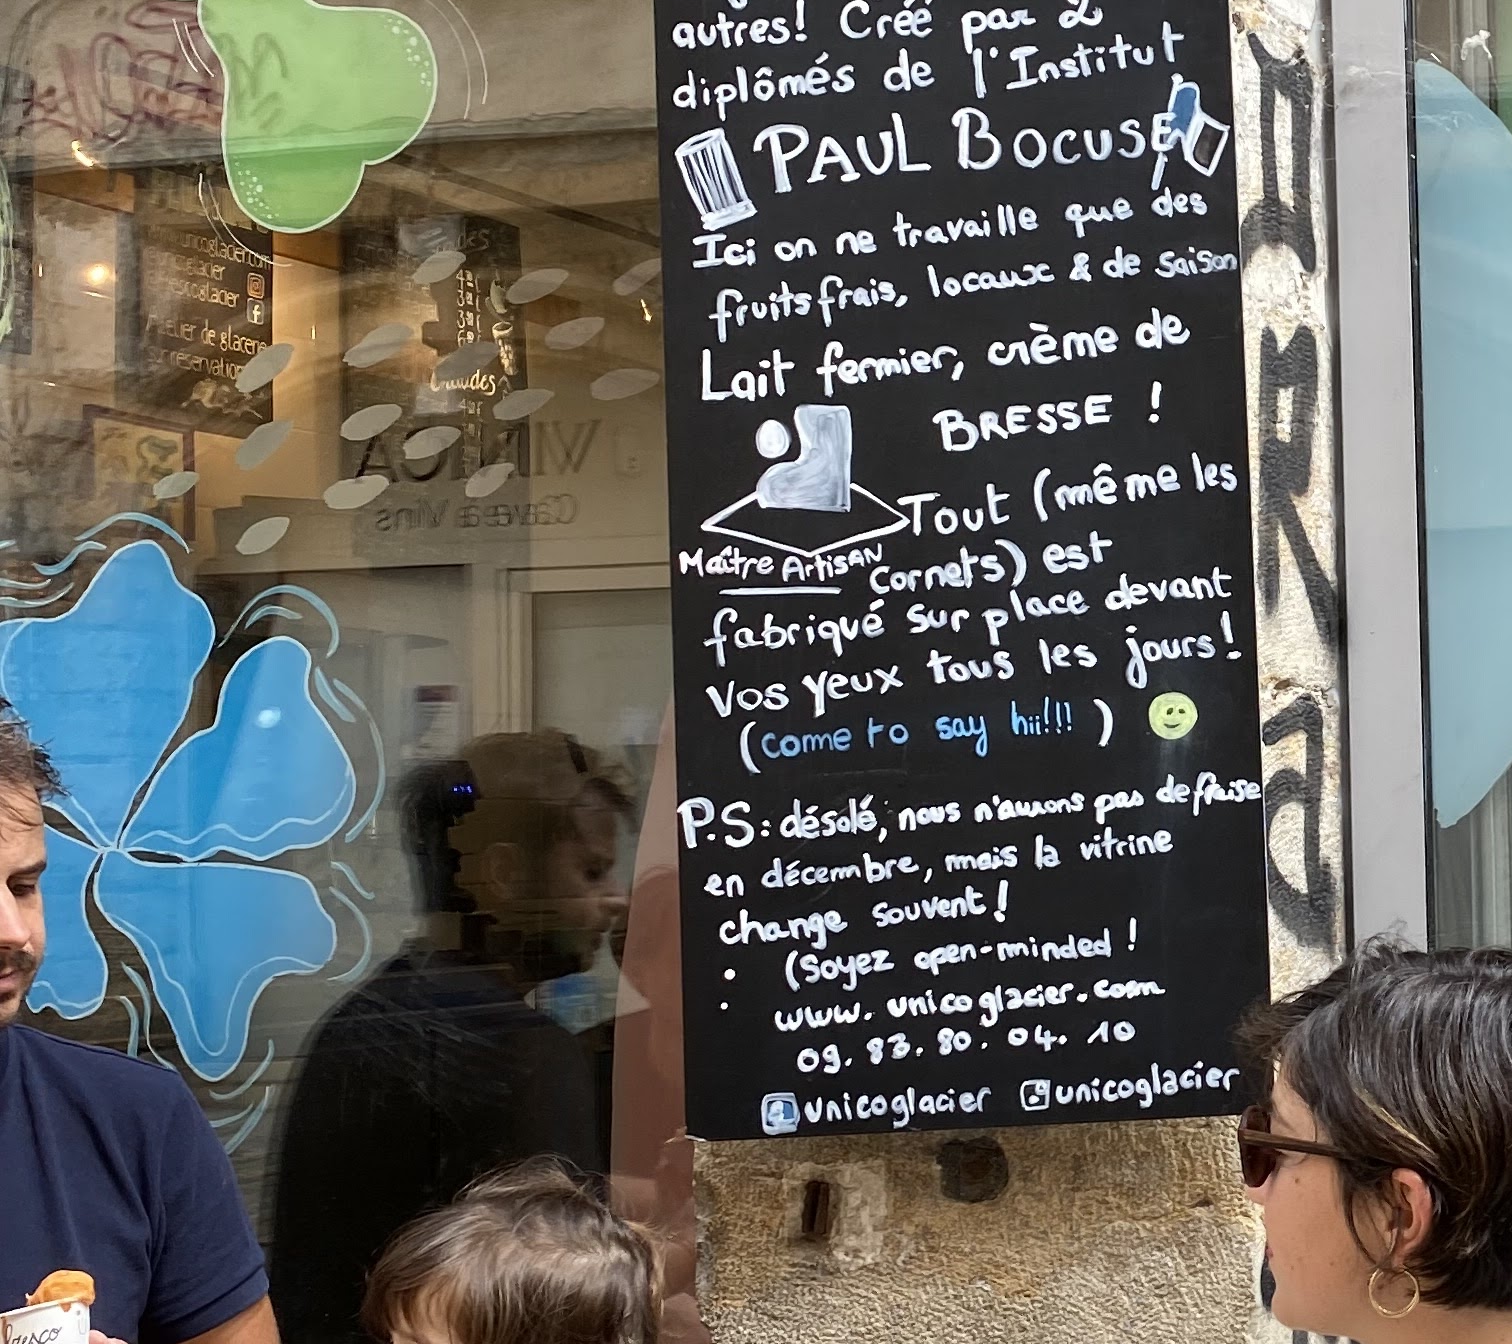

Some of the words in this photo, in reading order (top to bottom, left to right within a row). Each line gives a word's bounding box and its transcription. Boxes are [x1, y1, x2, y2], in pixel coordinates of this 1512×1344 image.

[672, 0, 807, 51] autres!
[961, 5, 1037, 53] par
[673, 52, 856, 122] diplômés
[882, 62, 936, 94] de
[972, 21, 1186, 99] l'Institut
[753, 112, 931, 195] PAUL
[692, 234, 756, 268] Ici
[774, 236, 818, 262] on
[835, 227, 877, 255] ne
[891, 202, 1040, 248] travaille
[1064, 196, 1135, 238] que
[1150, 186, 1209, 218] des
[708, 280, 812, 343] fruits
[818, 274, 910, 328] frais,
[926, 262, 1056, 299] locaux
[1069, 252, 1092, 283] &
[1101, 245, 1142, 280] de
[200, 319, 217, 347] de
[700, 348, 795, 402] Lait
[816, 340, 965, 397] fermier,
[987, 321, 1119, 367] crème
[1134, 306, 1191, 351] de
[932, 392, 1114, 454] BRESSE
[1147, 380, 1164, 425] !
[895, 483, 1011, 538] Tout
[1033, 462, 1182, 523] (même
[1190, 451, 1240, 495] les
[678, 547, 775, 580] Maître
[1043, 532, 1114, 575] est
[703, 597, 886, 668] fabriqué
[906, 601, 969, 635] sur
[983, 589, 1091, 646] place
[1104, 566, 1234, 611] devant
[801, 664, 905, 718] yeux
[926, 647, 1016, 686] tous
[1041, 637, 1099, 676] les
[1125, 610, 1243, 690] jours!
[866, 716, 911, 748] to
[934, 711, 989, 757] say
[1009, 696, 1074, 738] hii!!!
[1094, 698, 1114, 747] )
[897, 803, 962, 833] nous
[972, 789, 1087, 824] n'aurons
[1093, 788, 1146, 825] pas
[1156, 775, 1189, 805] de
[1189, 770, 1263, 818] fraise
[702, 871, 746, 899] en
[760, 851, 936, 892] décembre,
[944, 842, 1020, 874] mais
[1034, 835, 1062, 871] la
[1079, 826, 1175, 862] vitrine
[718, 905, 849, 950] change
[914, 927, 1112, 974] open-minded
[803, 1087, 994, 1130] unicoglacier
[1054, 1062, 1241, 1107] unicoglacier
